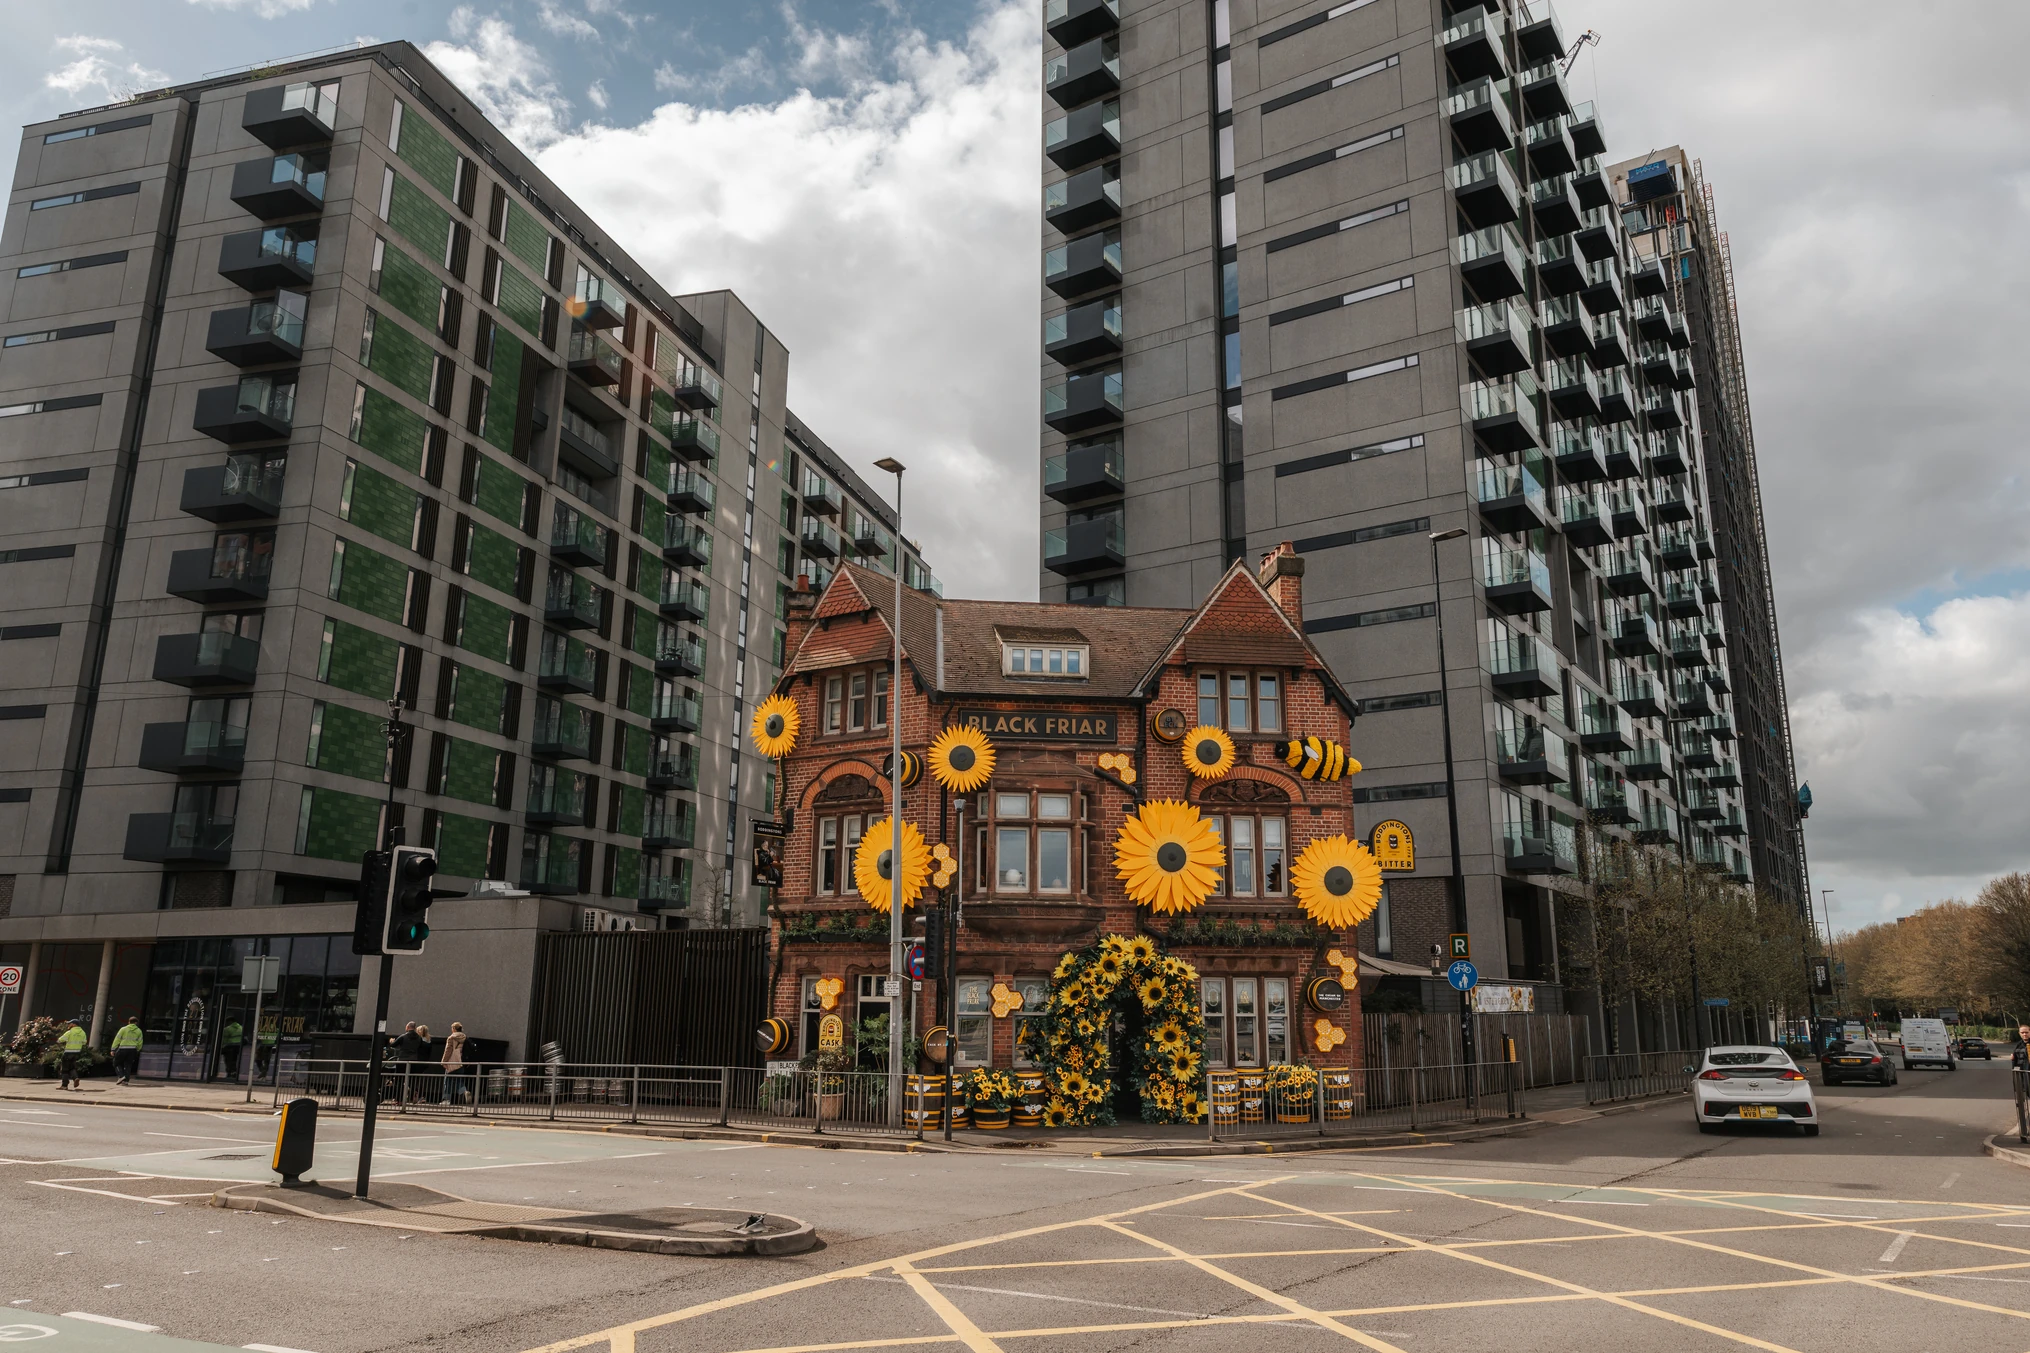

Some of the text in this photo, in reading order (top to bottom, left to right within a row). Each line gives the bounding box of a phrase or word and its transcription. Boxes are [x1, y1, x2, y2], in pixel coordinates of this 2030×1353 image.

[968, 715, 1107, 735] BLACK FRIAR
[1376, 822, 1412, 844] BODDINGTONS
[1455, 939, 1466, 953] R
[3, 972, 17, 981] 20
[282, 1016, 305, 1033] FRIAR
